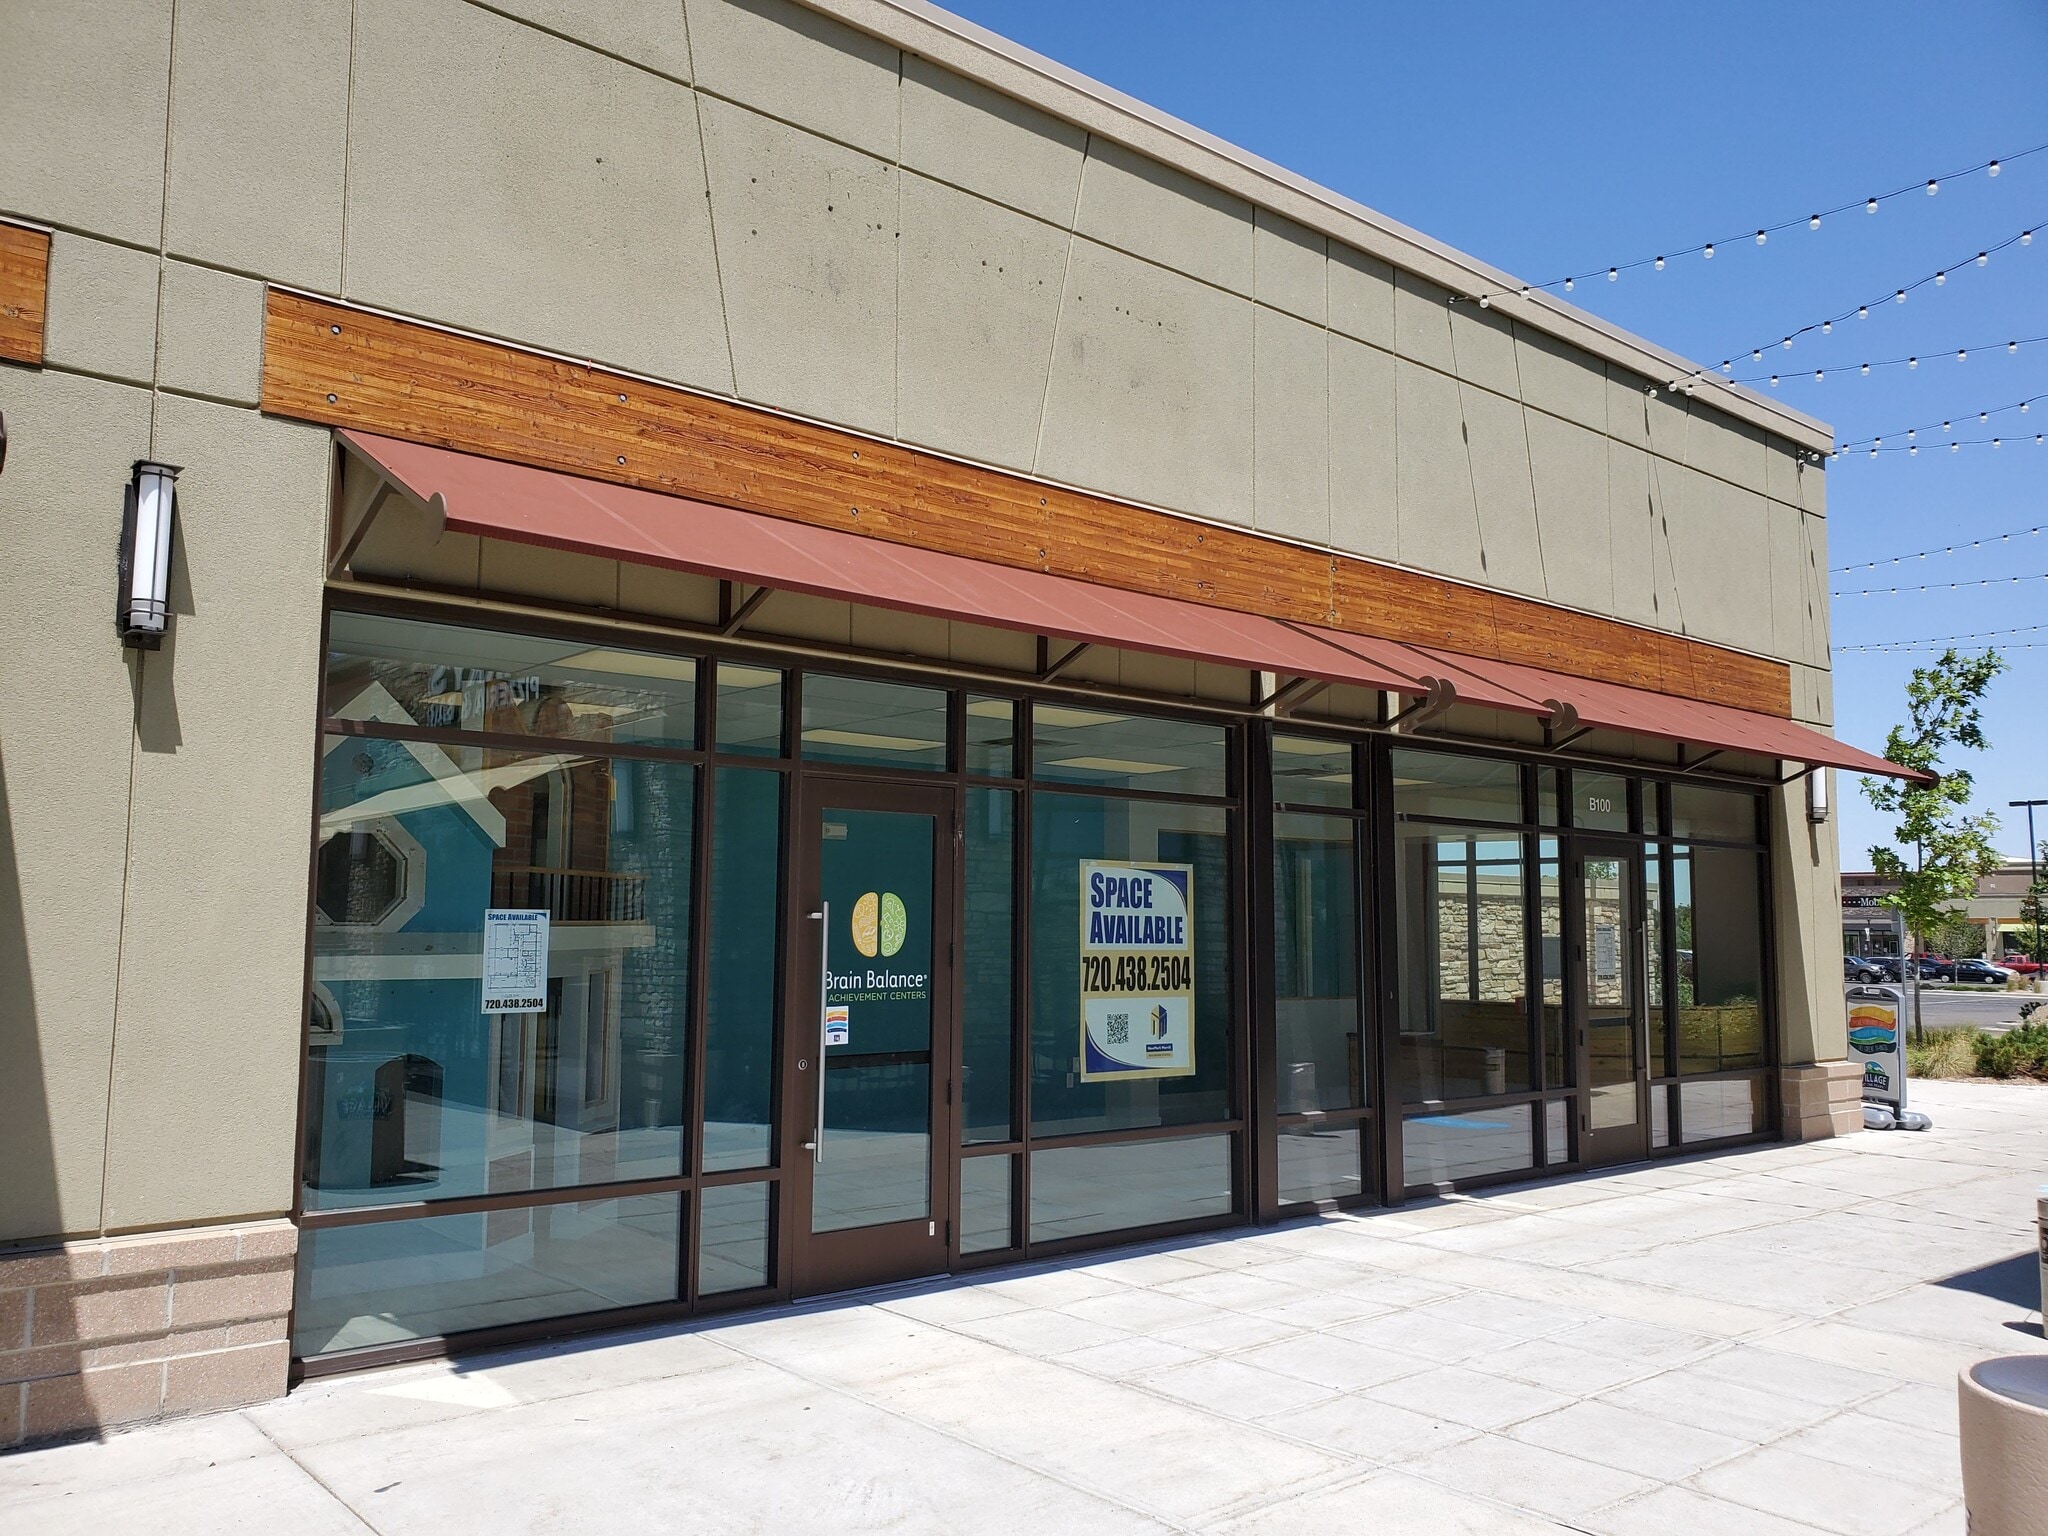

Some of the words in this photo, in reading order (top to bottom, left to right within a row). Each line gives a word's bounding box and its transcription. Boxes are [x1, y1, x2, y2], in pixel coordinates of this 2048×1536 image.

[1589, 797, 1611, 813] B100
[1090, 871, 1153, 909] SPACE
[487, 913, 507, 921] SPACE
[507, 913, 538, 921] AVAILABLE
[1089, 911, 1184, 945] AVAILABLE
[826, 970, 862, 990] Brain
[1082, 955, 1191, 992] 720.438.2504
[484, 998, 544, 1009] 720.438.2504
[827, 992, 888, 1003] ACHIEVEMENT
[889, 990, 927, 1001] CENTERS
[1864, 1073, 1887, 1086] ILLAGE
